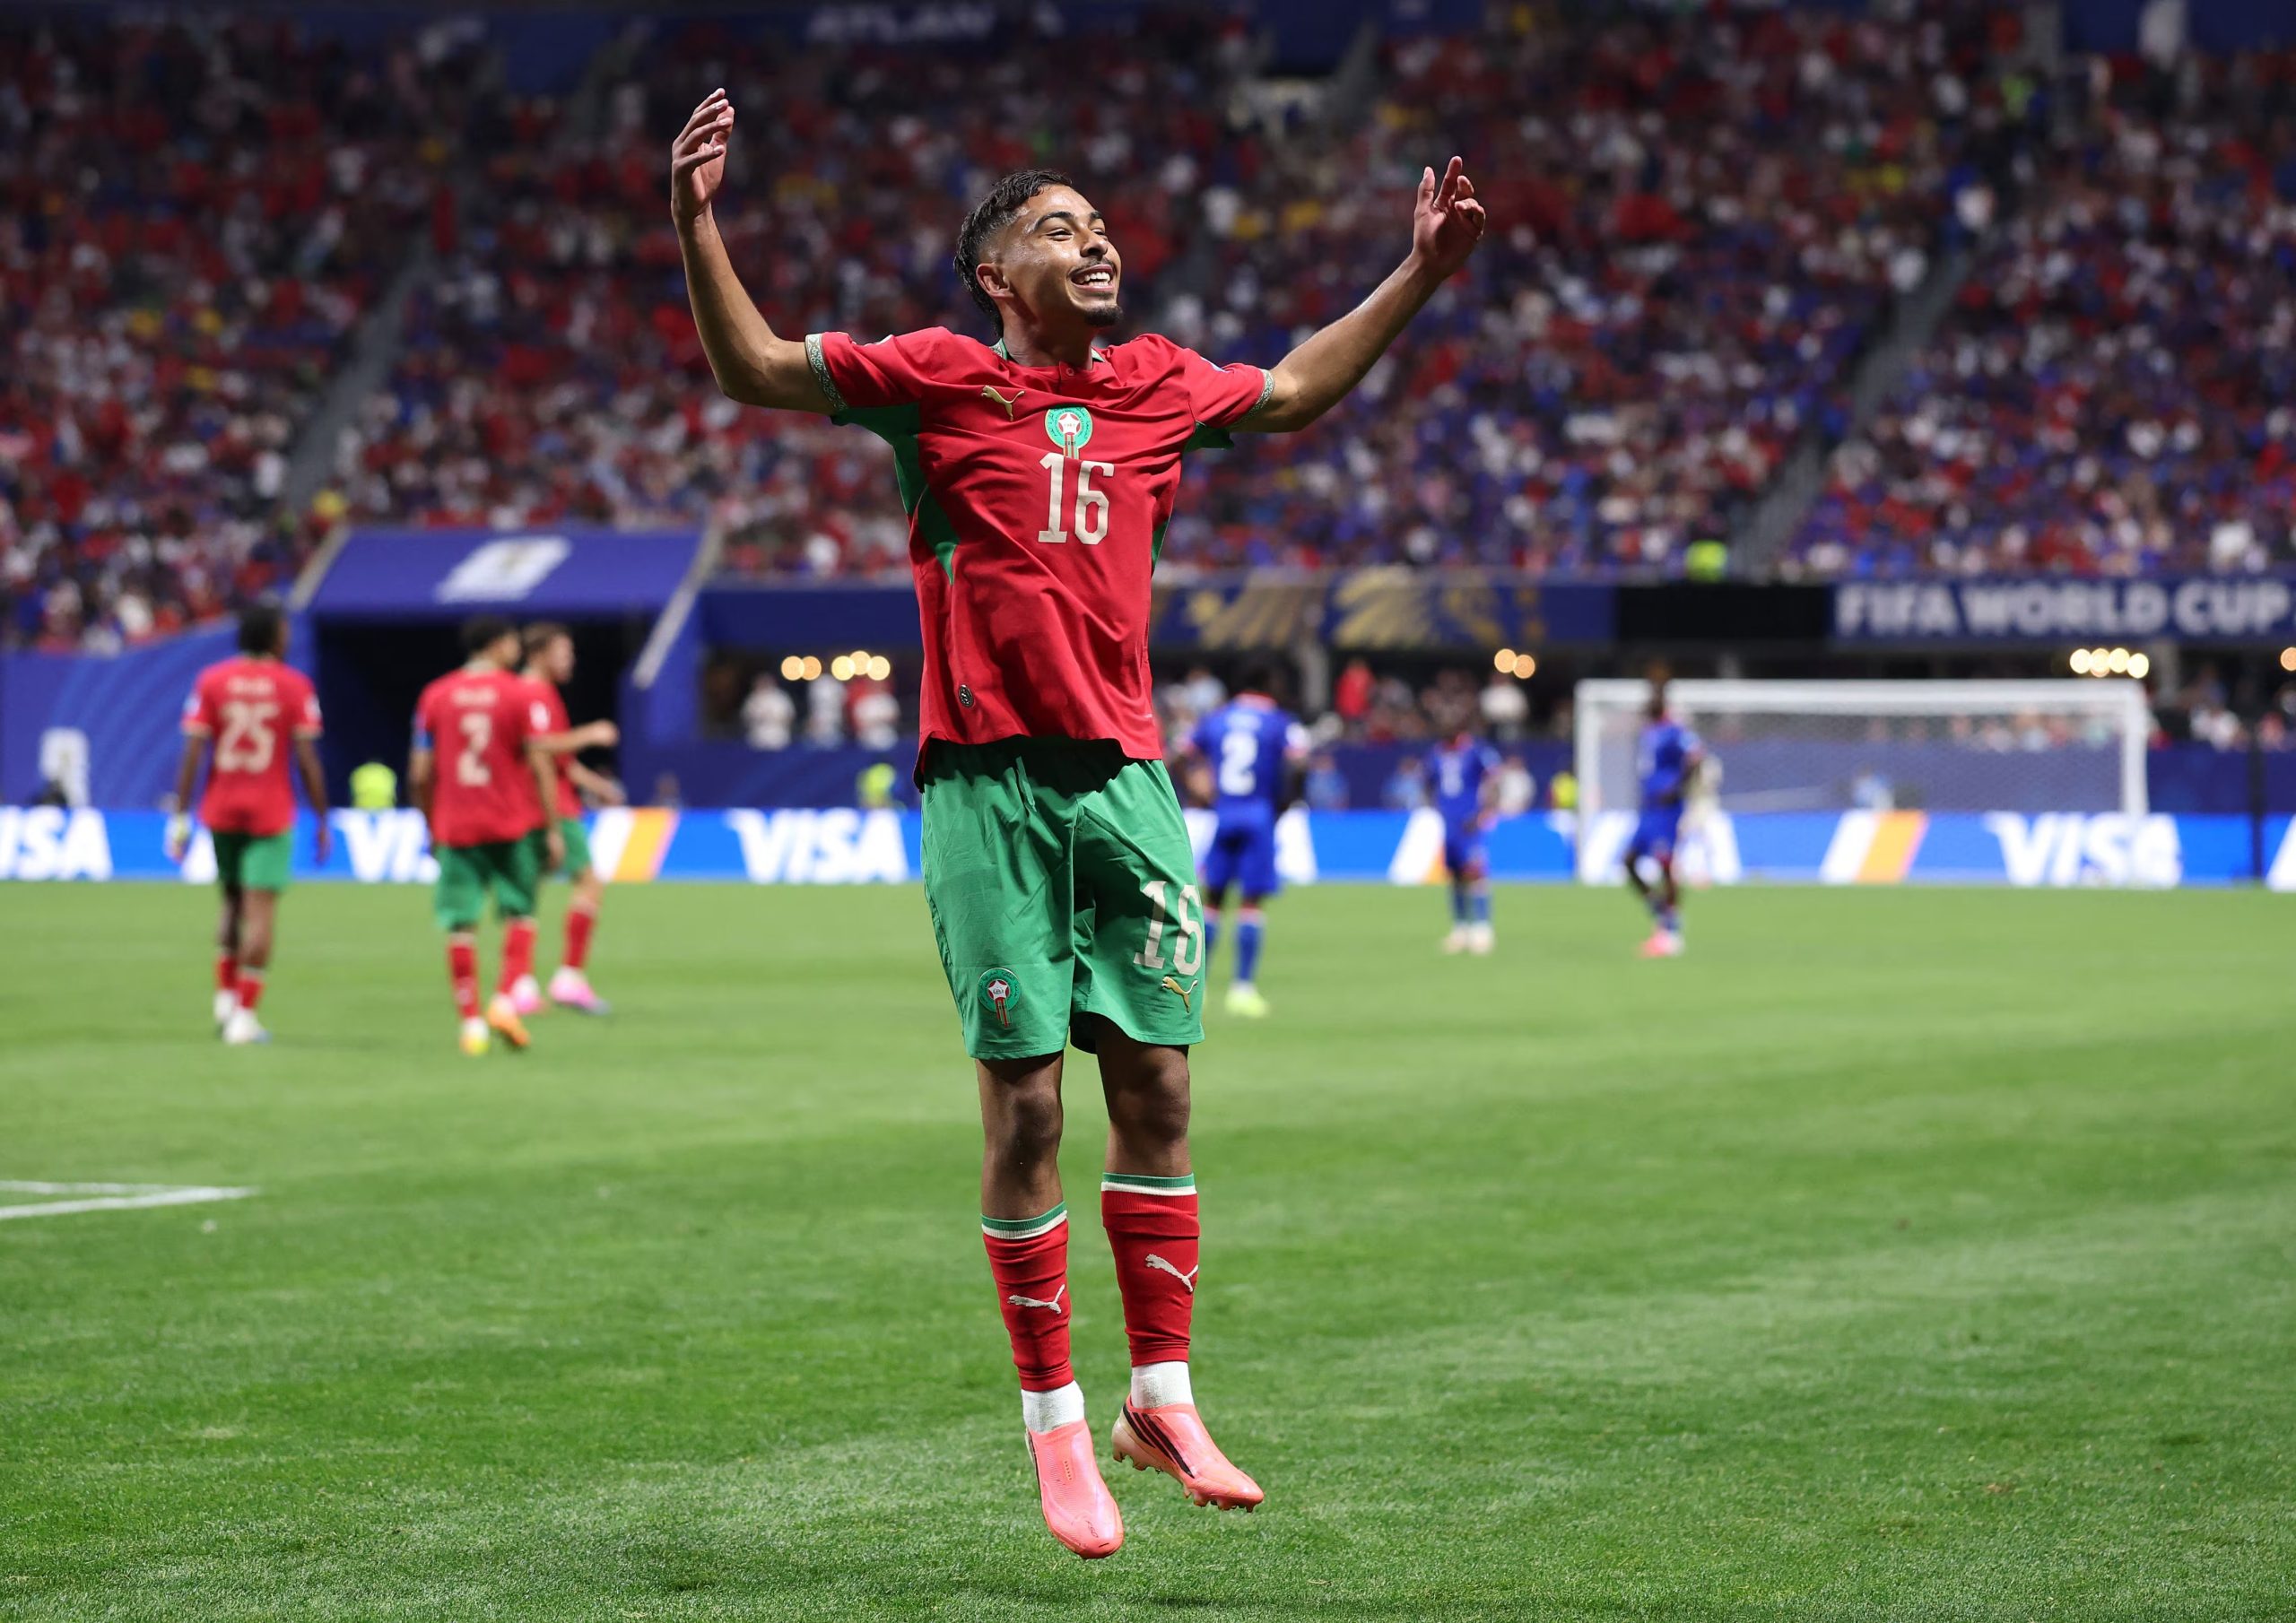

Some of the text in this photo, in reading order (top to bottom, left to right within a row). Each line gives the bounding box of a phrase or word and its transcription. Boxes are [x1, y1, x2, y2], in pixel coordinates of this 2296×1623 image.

[1038, 452, 1115, 545] 16
[1836, 581, 2290, 635] FIFA WORLD CUP
[216, 701, 280, 773] 25
[458, 713, 492, 786] 2
[1219, 731, 1258, 796] 2
[0, 806, 113, 881] ISA
[725, 808, 909, 884] VISA
[1983, 811, 2183, 888] VISA
[1133, 880, 1203, 976] 16
